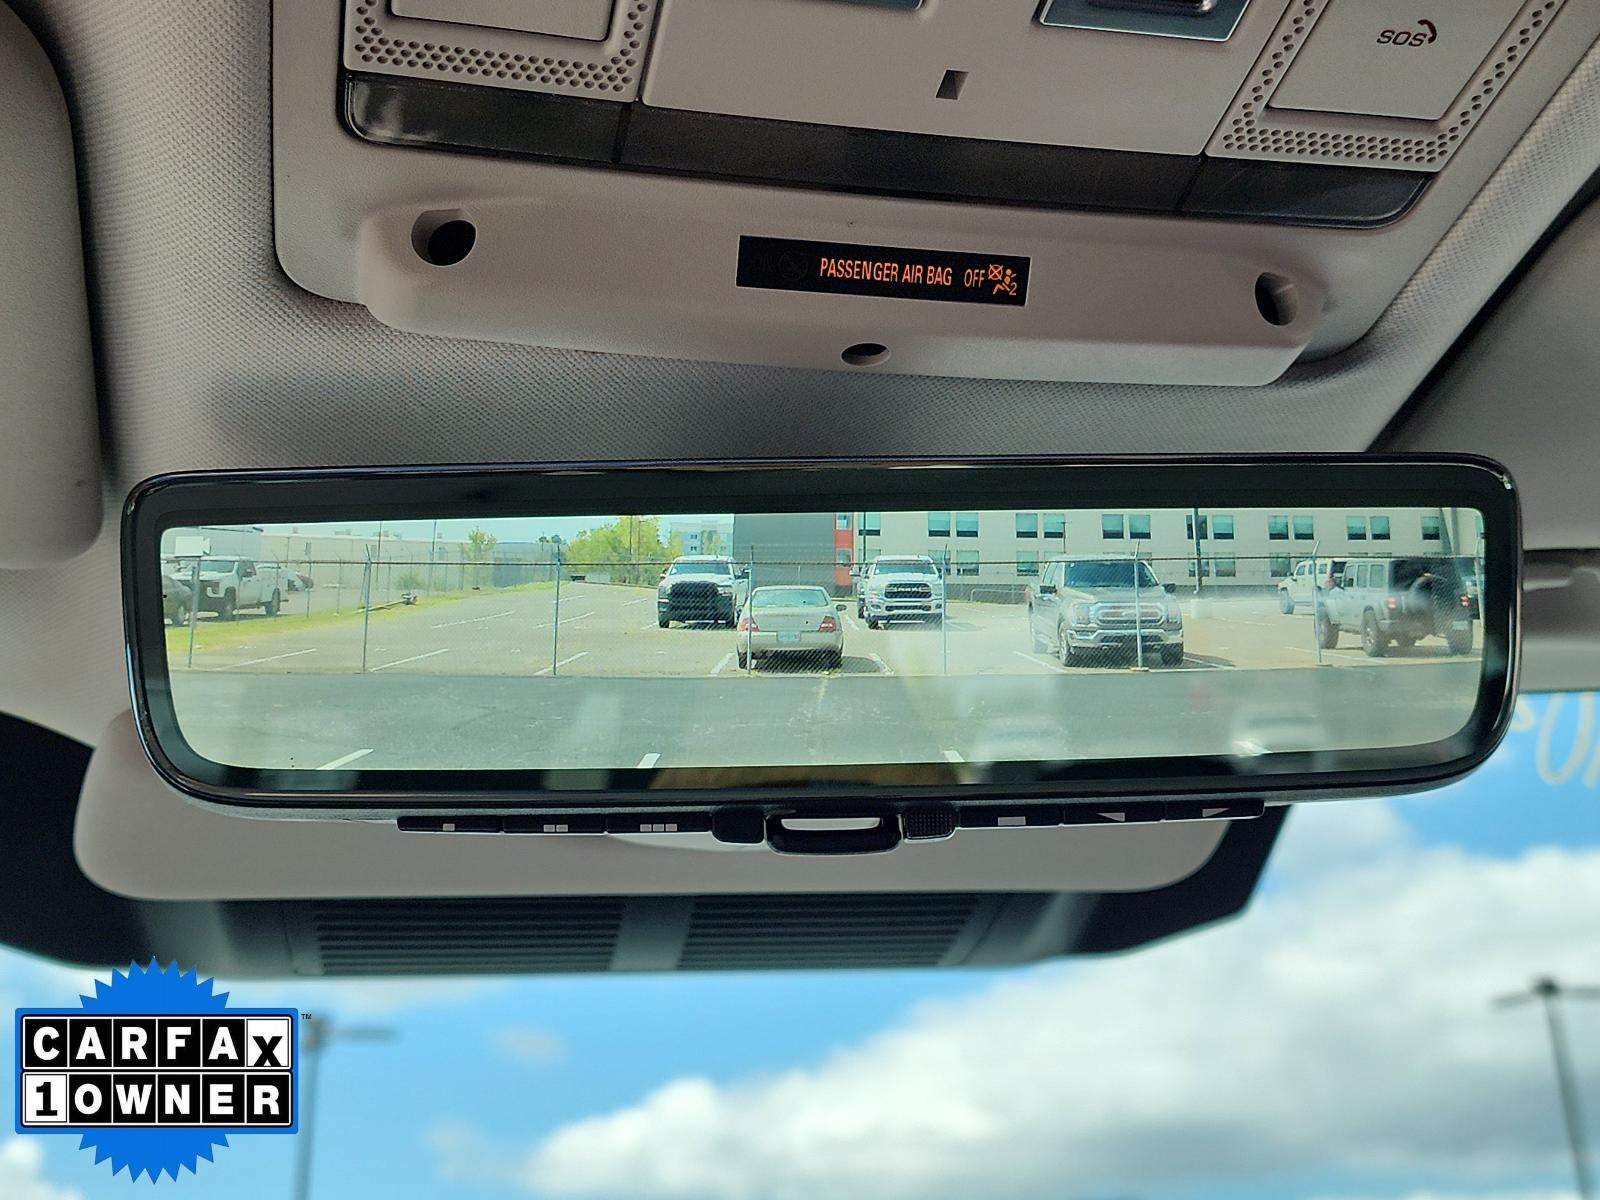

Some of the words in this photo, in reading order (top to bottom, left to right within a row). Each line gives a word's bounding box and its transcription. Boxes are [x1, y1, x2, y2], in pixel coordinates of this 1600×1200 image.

[1376, 29, 1427, 47] SOS
[819, 257, 898, 283] PASSENGER
[902, 264, 923, 284] AIR
[926, 266, 953, 286] BAG
[963, 268, 985, 288] OFF
